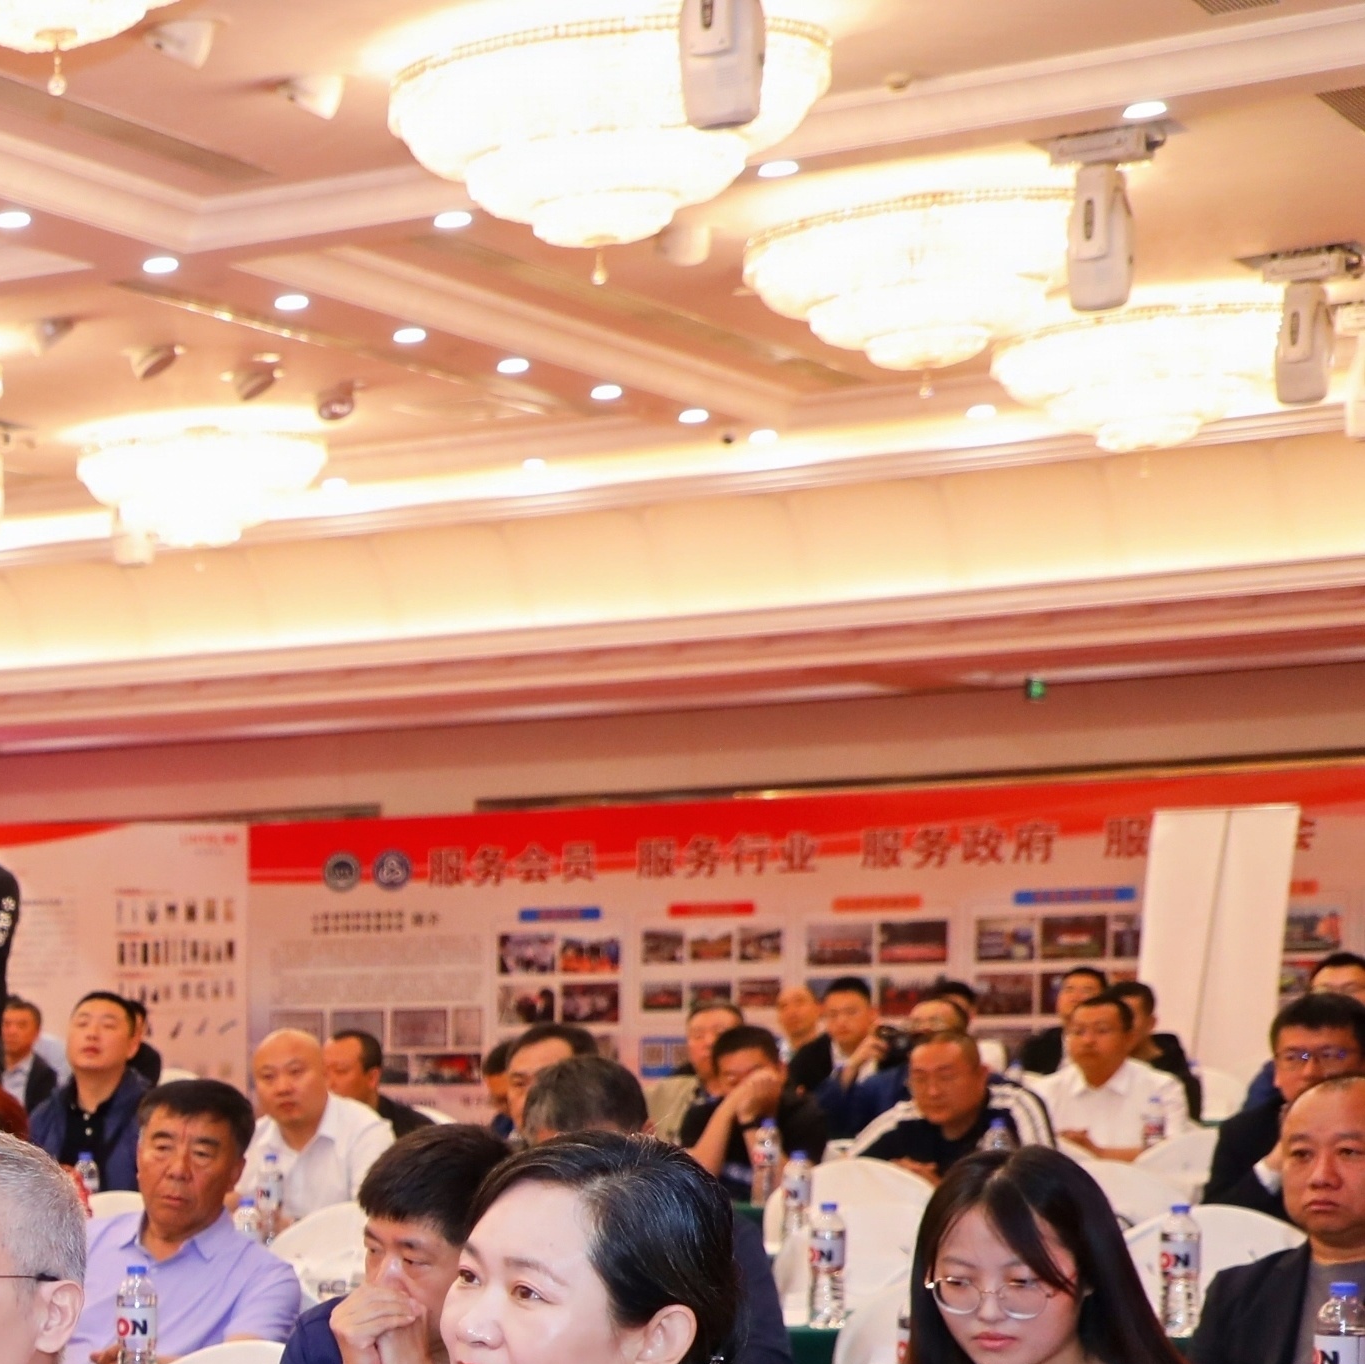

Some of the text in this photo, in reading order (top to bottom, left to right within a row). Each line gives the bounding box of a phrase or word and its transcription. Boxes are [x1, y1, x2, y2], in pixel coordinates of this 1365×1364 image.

[427, 840, 597, 889] 服务会员
[636, 830, 818, 879] 服务行业
[860, 819, 1059, 869] 服务政府
